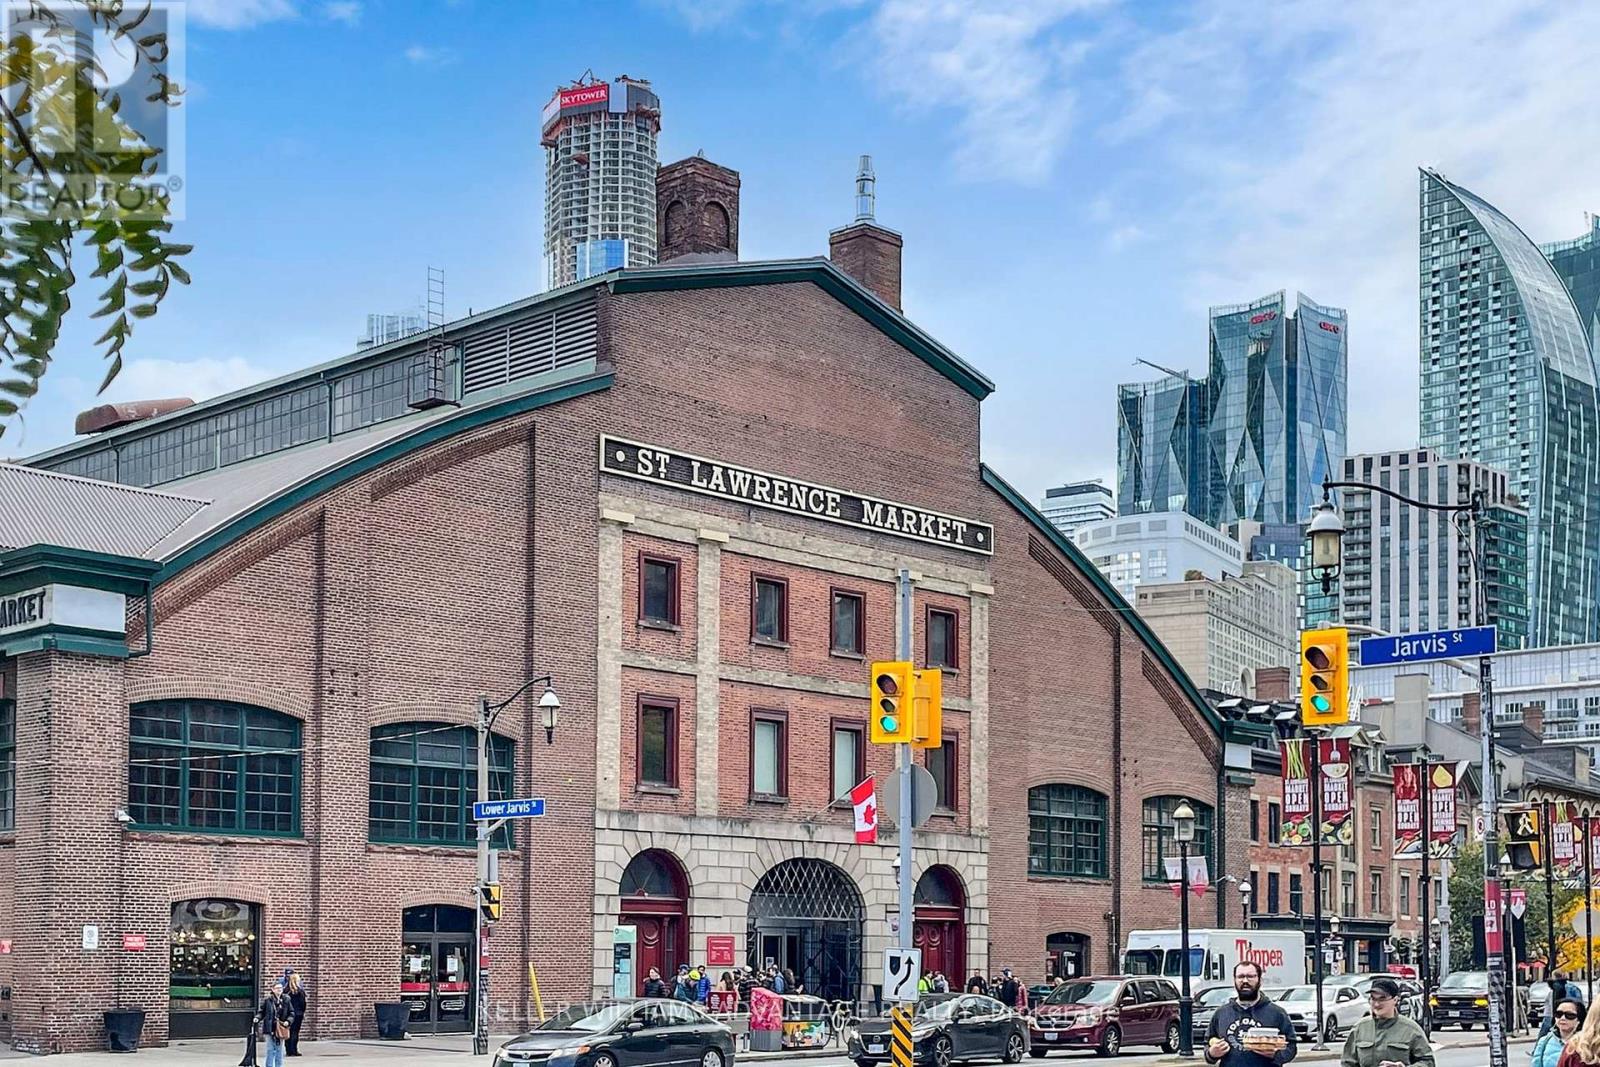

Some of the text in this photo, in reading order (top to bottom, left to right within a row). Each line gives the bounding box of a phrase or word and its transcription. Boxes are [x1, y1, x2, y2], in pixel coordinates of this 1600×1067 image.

[561, 89, 607, 105] SKYTOWER
[691, 460, 841, 518] LAWRENCE
[861, 499, 968, 545] MARKET
[1391, 632, 1463, 657] Jarvis St
[1285, 793, 1309, 805] OPEN
[1324, 791, 1348, 804] OPEN
[481, 803, 505, 816] Lower
[506, 801, 531, 814] Jarvis
